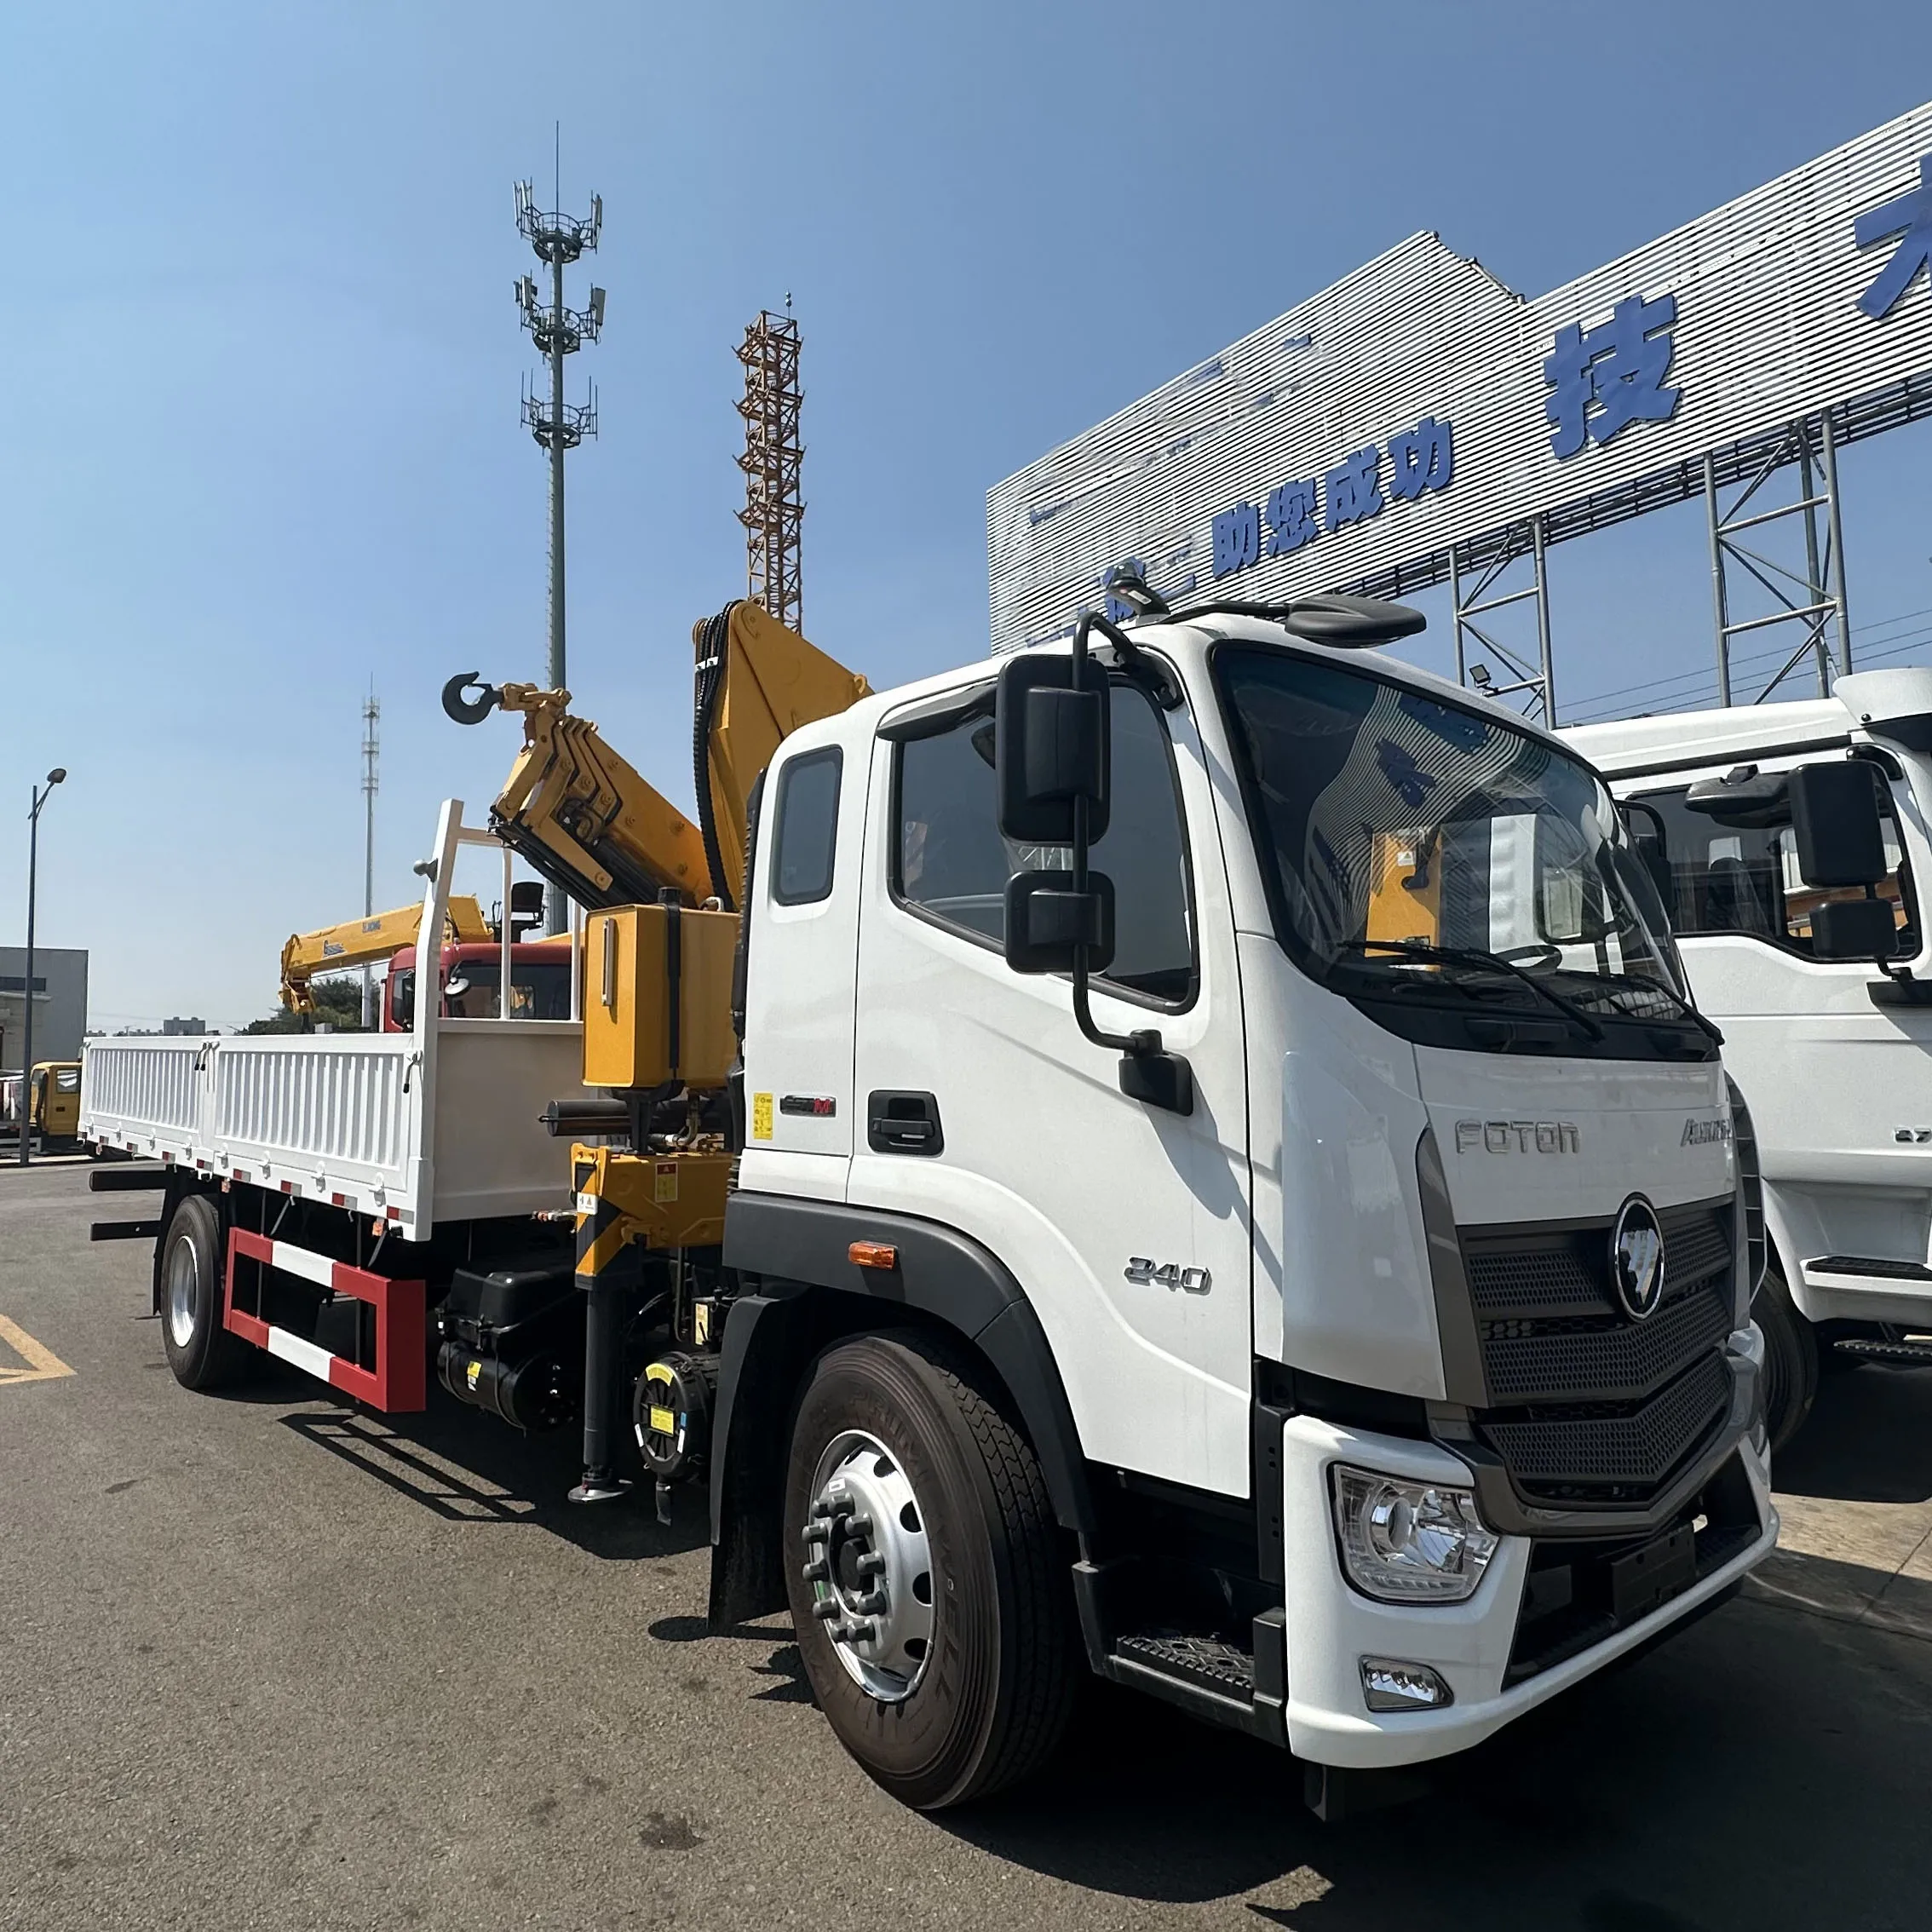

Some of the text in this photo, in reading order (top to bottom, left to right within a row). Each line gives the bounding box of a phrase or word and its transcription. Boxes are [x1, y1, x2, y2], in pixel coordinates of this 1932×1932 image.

[1212, 415, 1455, 580] 助您成功
[1455, 1118, 1582, 1155] FOTON
[1124, 1256, 1213, 1296] 240
